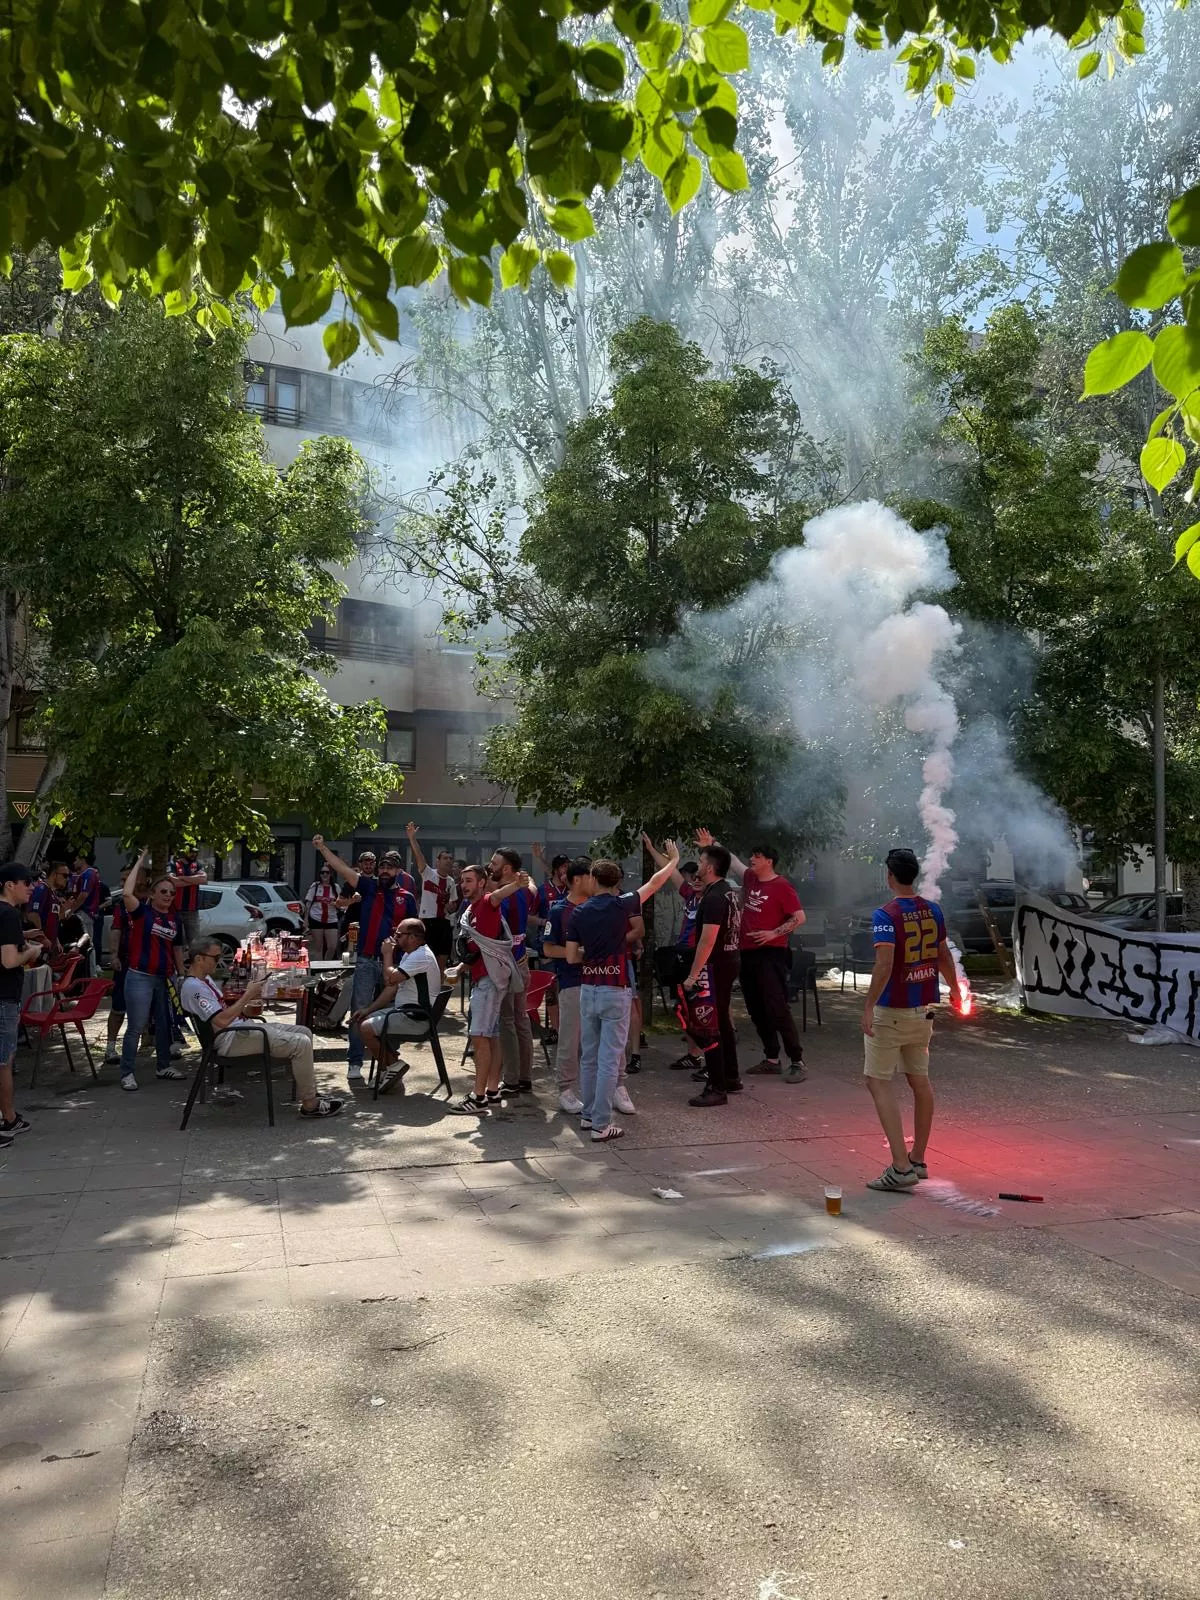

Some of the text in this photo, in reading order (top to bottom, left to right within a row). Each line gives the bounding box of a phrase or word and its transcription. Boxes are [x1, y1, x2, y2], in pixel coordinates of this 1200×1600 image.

[902, 909, 933, 921] SASTRE
[903, 918, 938, 963] 22
[906, 967, 936, 981] AMBAR
